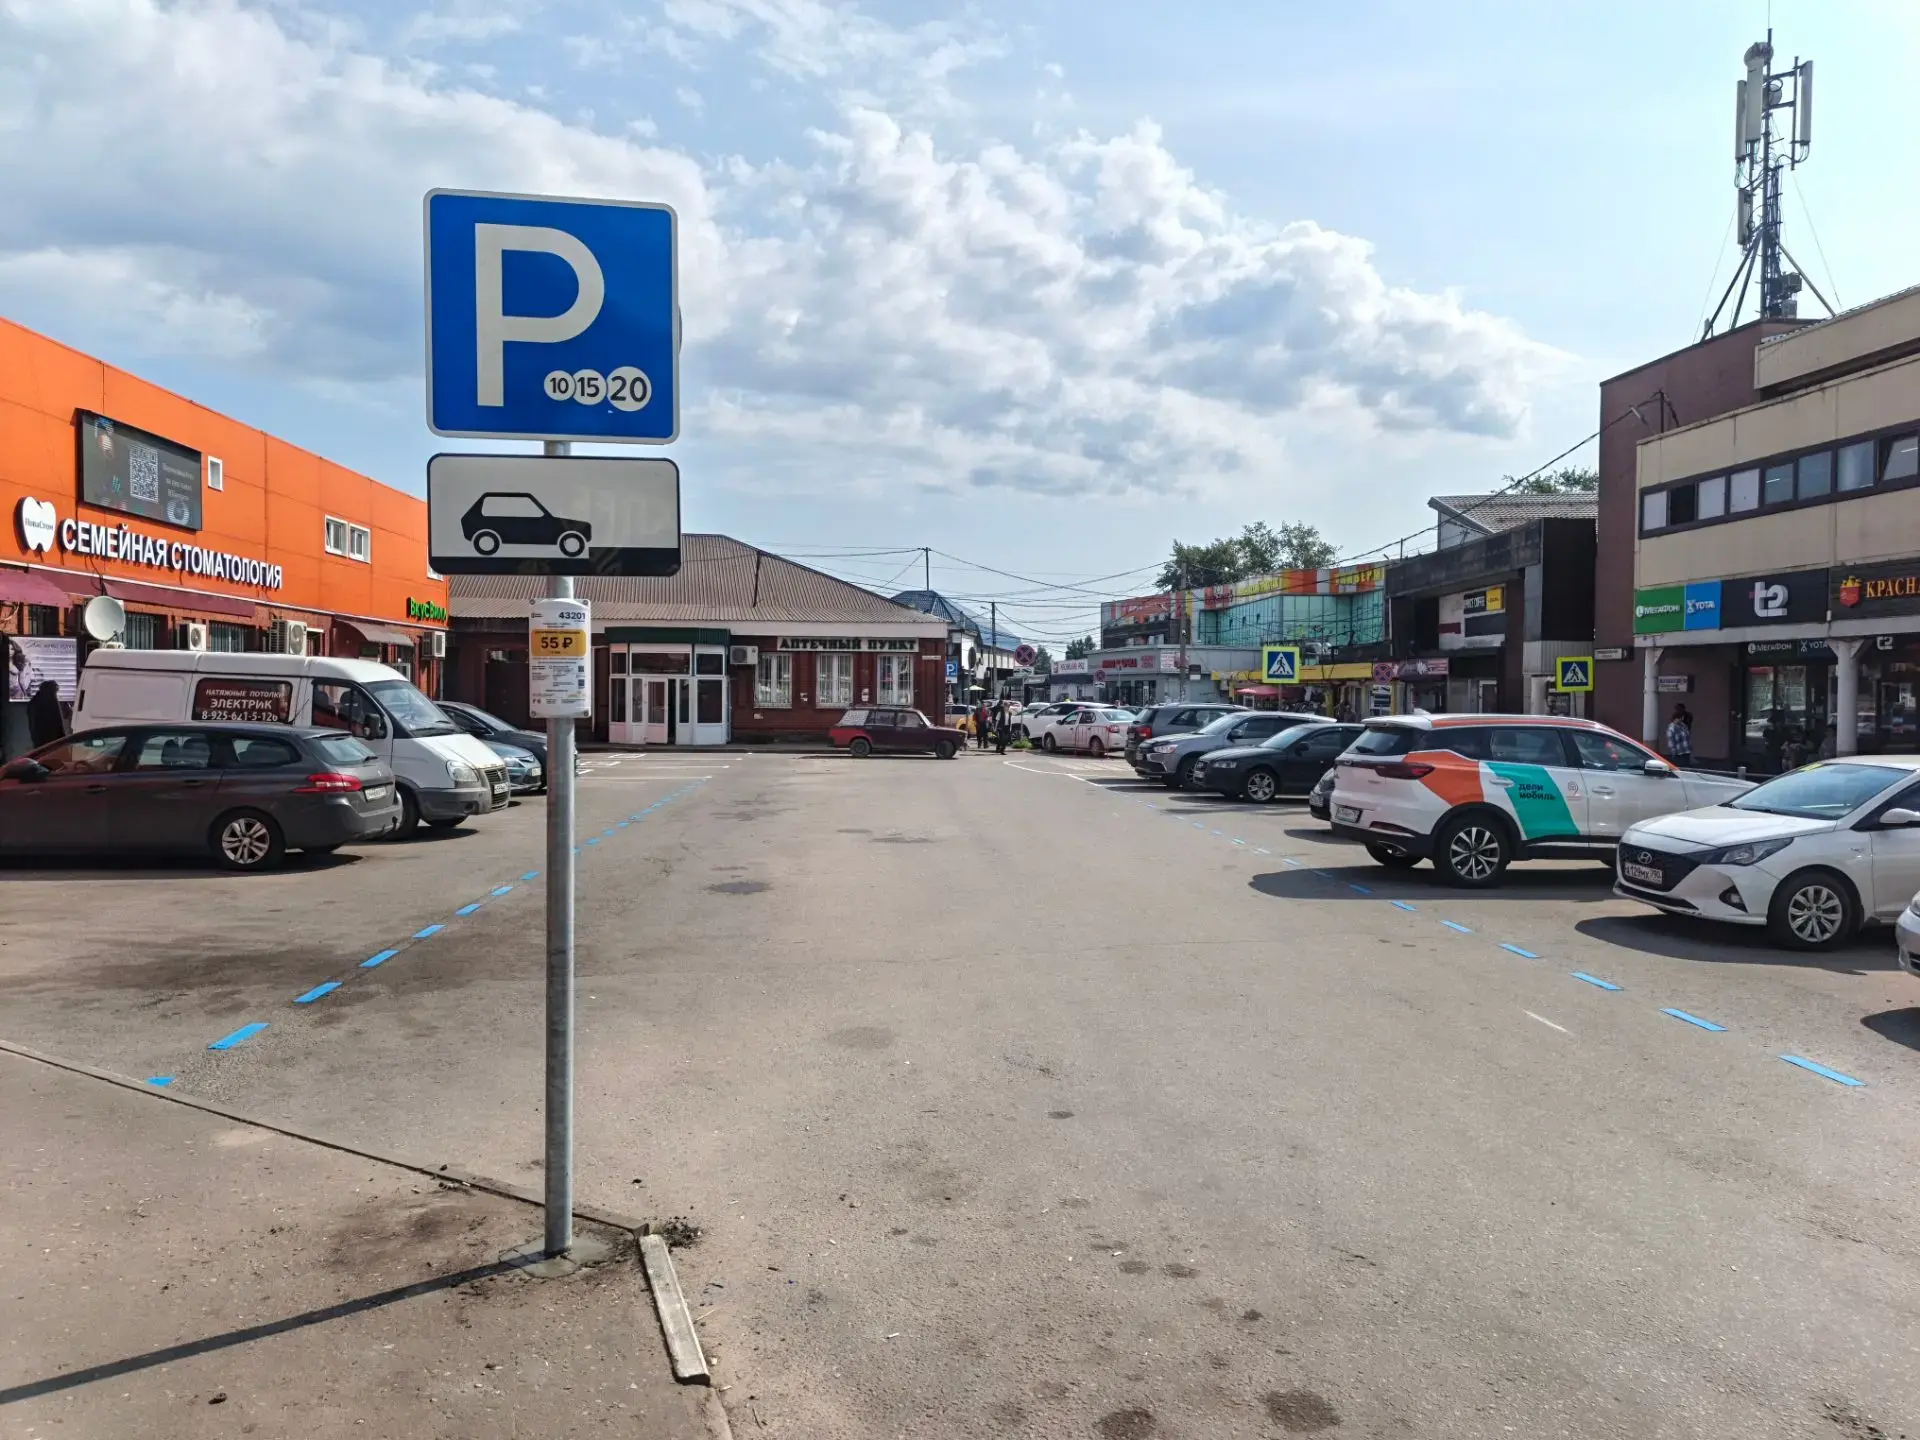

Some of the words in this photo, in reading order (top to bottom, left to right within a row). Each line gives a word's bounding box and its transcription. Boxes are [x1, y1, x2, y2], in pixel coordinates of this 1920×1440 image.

[475, 223, 606, 407] P
[550, 377, 569, 394] 10
[577, 377, 600, 398] 15
[611, 376, 648, 403] 20
[62, 518, 168, 567] СЕМЕЙНАЯ
[171, 541, 283, 590] СТОМАТОЛОГИЯ
[1865, 577, 1920, 599] КРАСН
[559, 611, 586, 620] 43201
[541, 637, 559, 649] 55
[780, 638, 861, 650] АПТЕЧНЫЙ
[867, 638, 917, 650] ПУНКТ
[210, 699, 272, 710] ЭЛЕКТРИК
